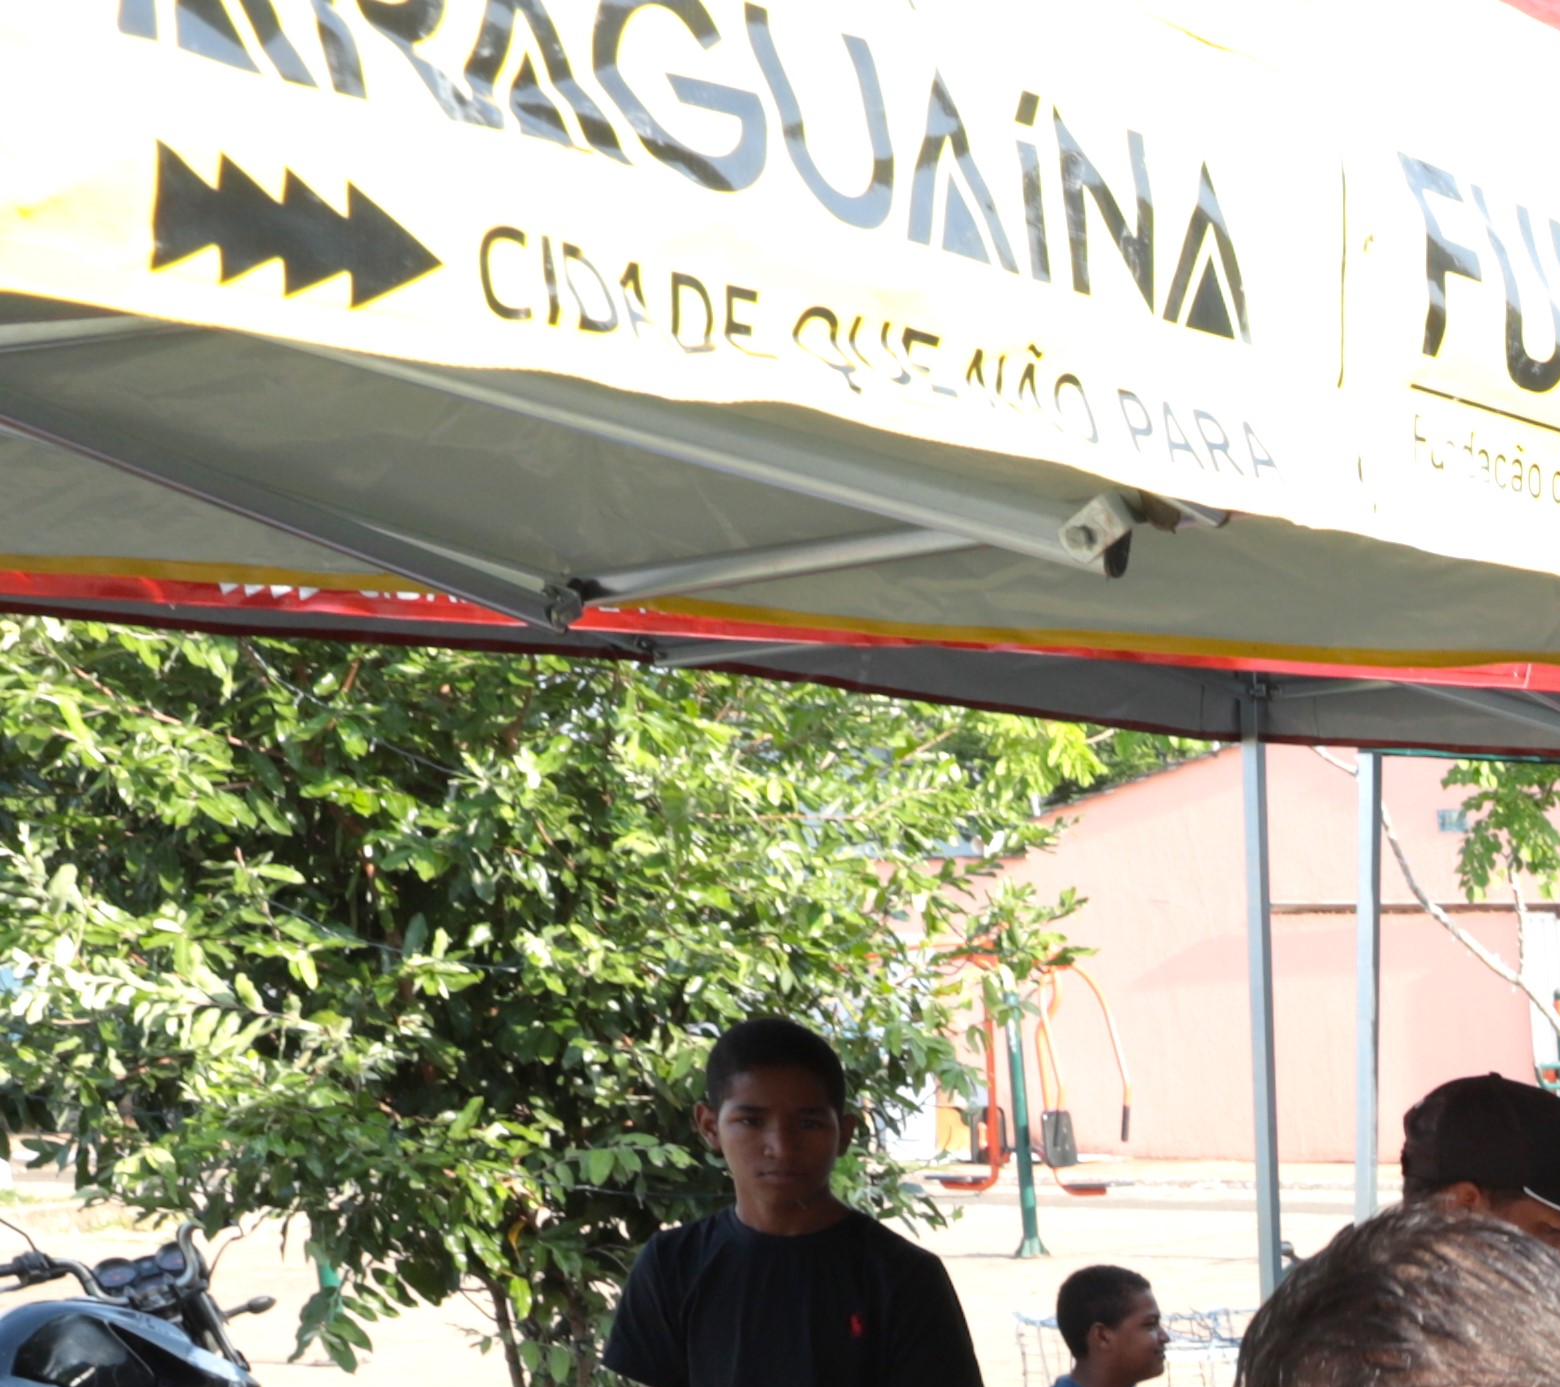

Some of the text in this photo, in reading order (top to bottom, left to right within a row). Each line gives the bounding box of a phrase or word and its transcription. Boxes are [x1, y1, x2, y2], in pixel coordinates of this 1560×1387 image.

[479, 225, 1286, 486] CIDADE QUE NÃO PARA
[1413, 413, 1542, 500] Fudação
